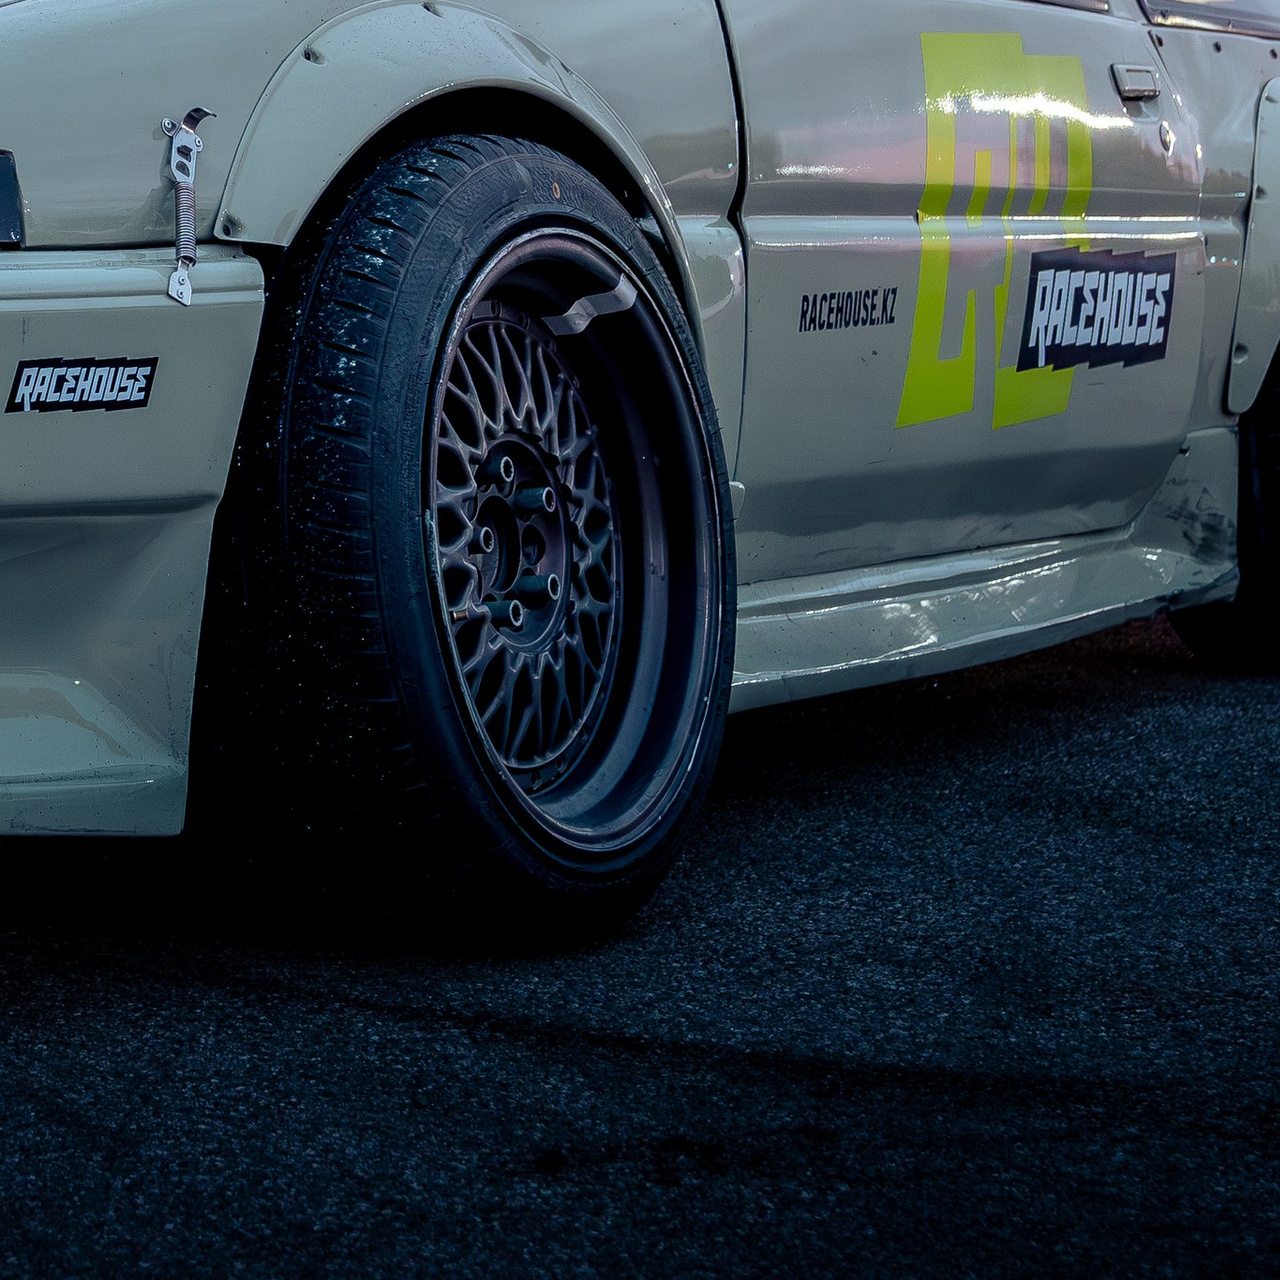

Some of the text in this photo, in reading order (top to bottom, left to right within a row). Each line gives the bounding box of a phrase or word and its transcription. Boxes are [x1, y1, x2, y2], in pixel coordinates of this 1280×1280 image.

[798, 286, 899, 333] RACEHOUSE.KZ
[1028, 269, 1170, 368] RACEHOUSE
[14, 366, 152, 412] RACEHOUSE
